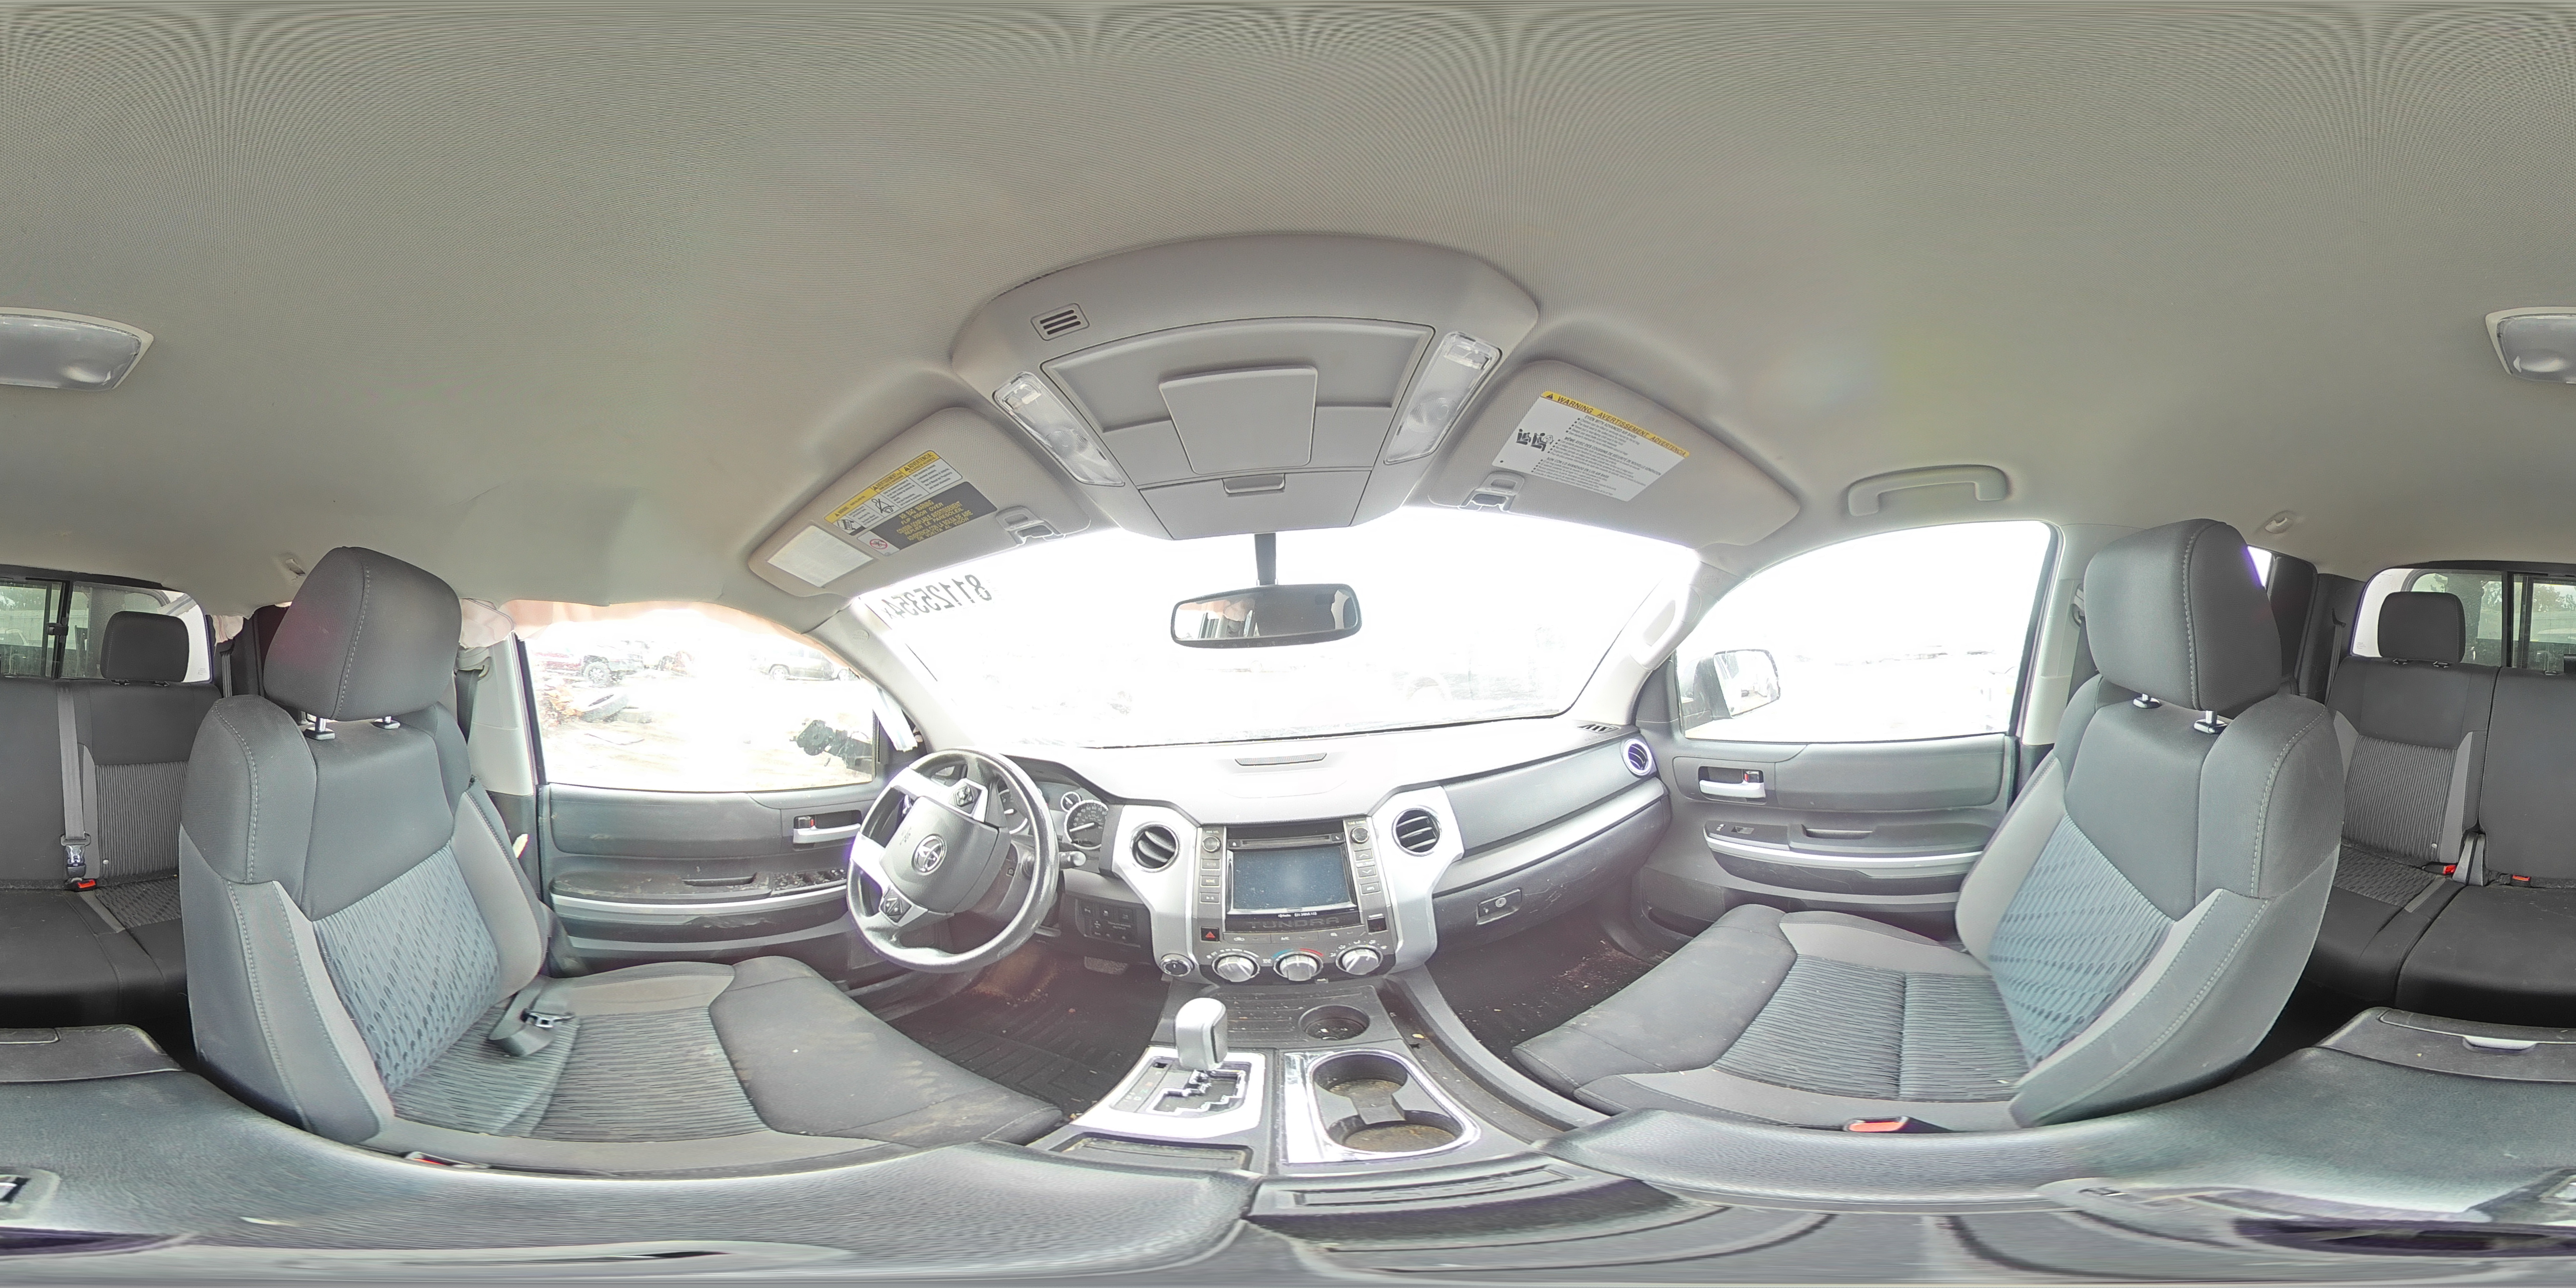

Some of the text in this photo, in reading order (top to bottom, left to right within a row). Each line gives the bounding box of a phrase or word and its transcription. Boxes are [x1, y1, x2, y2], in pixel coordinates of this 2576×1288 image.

[1557, 396, 1594, 414] WARNING
[1597, 412, 1650, 438] AVERTISSEMENT
[1650, 436, 1686, 456] ADVERTENCIA
[912, 510, 928, 519] VISOR
[929, 502, 943, 511] OVER
[932, 506, 964, 522] PARESOLEIL
[953, 517, 969, 525] VISOR
[1246, 916, 1340, 929] TUNDRA
